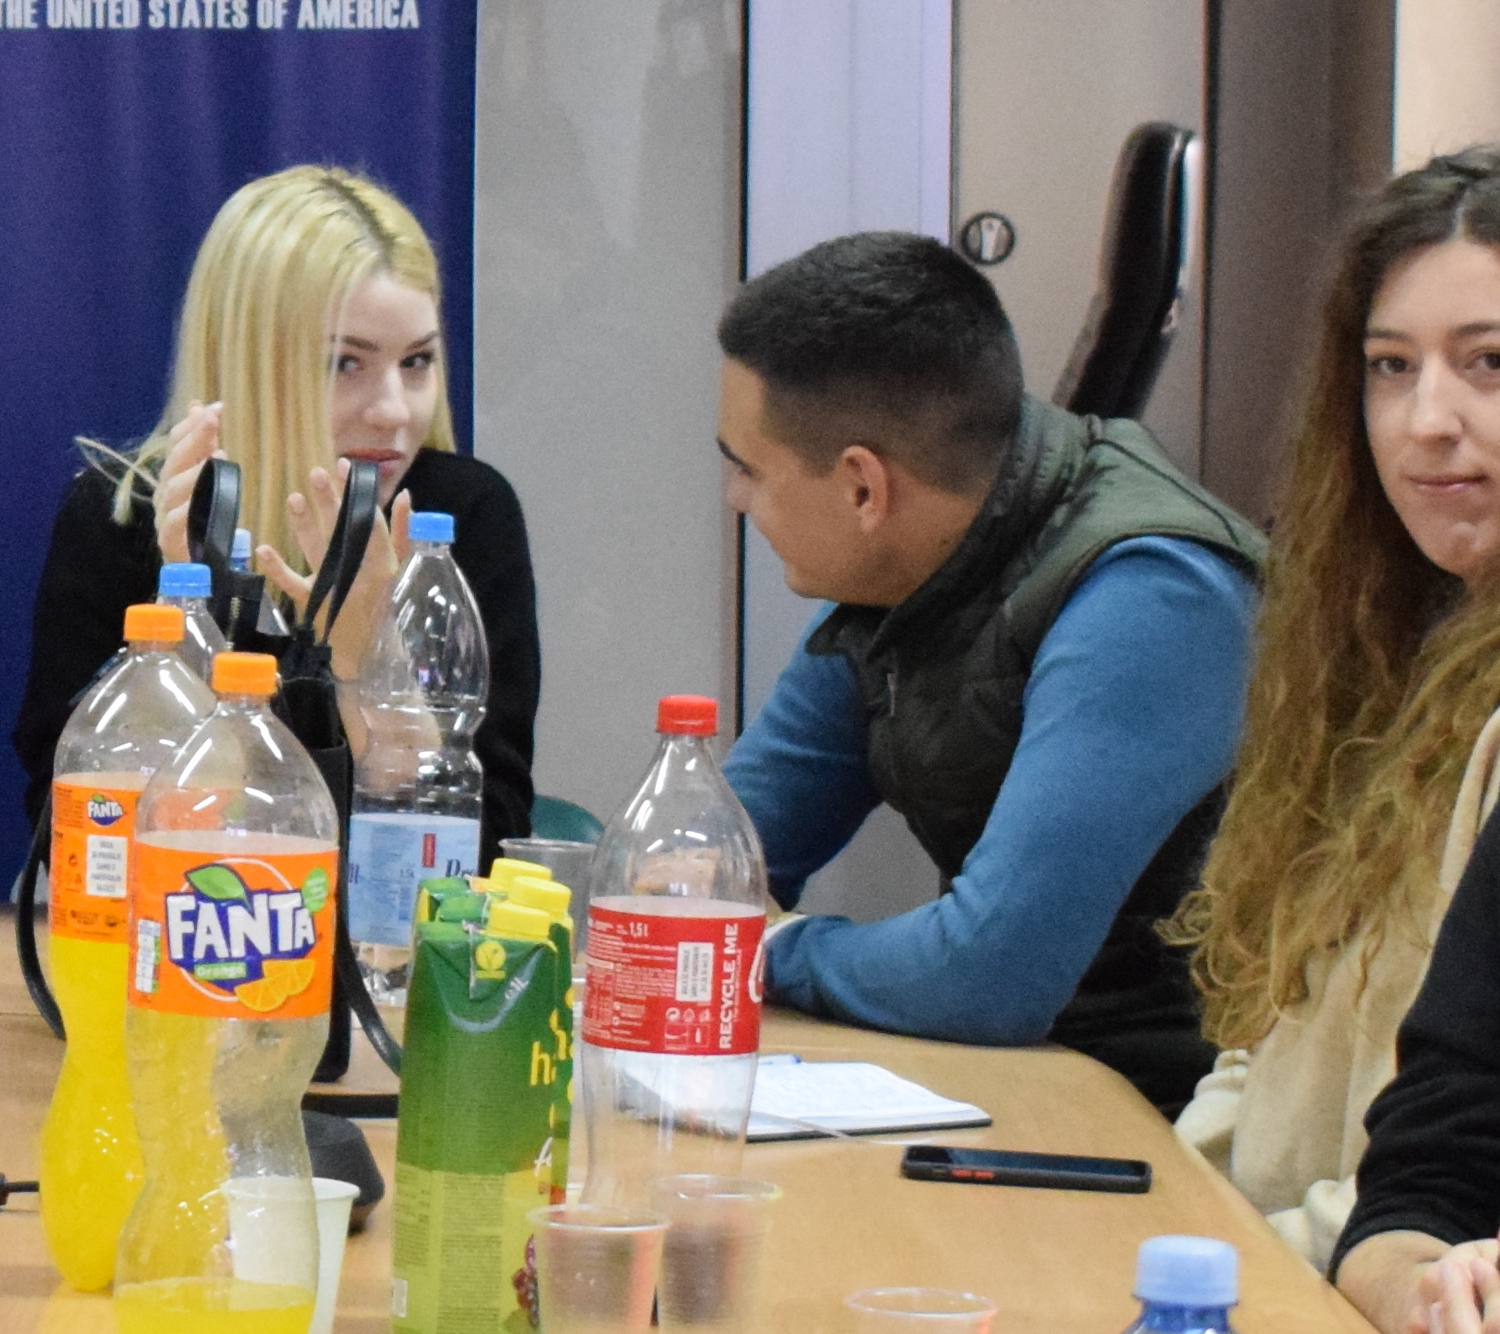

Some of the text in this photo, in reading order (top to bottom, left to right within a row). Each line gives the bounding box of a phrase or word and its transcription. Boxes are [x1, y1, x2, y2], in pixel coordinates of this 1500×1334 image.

[87, 801, 123, 817] FANTA
[165, 893, 316, 960] FANTA
[719, 923, 739, 1049] RECYCLE ME
